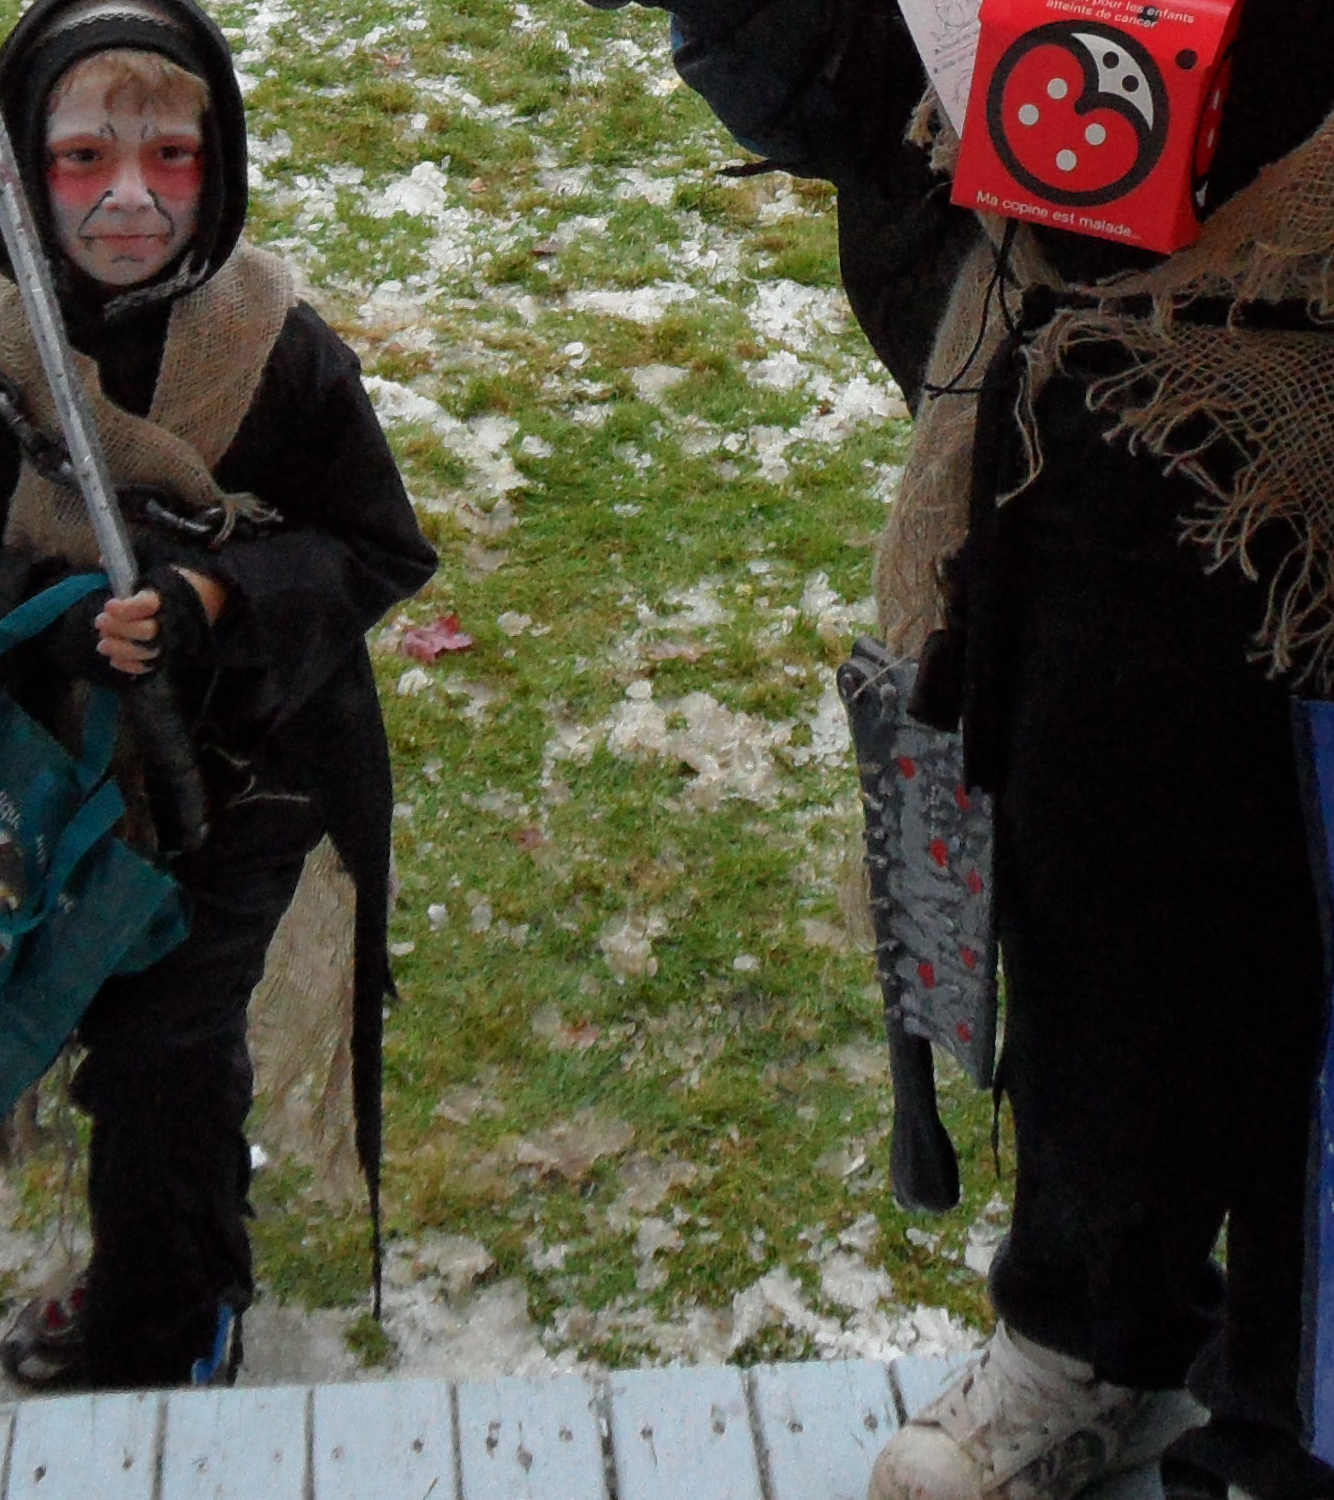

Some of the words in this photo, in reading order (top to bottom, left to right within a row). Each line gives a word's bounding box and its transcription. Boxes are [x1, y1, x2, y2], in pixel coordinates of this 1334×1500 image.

[1095, 8, 1112, 20] de
[1114, 13, 1159, 29] cancer
[1125, 1, 1144, 14] les
[1145, 5, 1195, 24] enfants
[976, 190, 998, 206] Ma
[1002, 200, 1049, 218] copine
[1052, 209, 1075, 225] est
